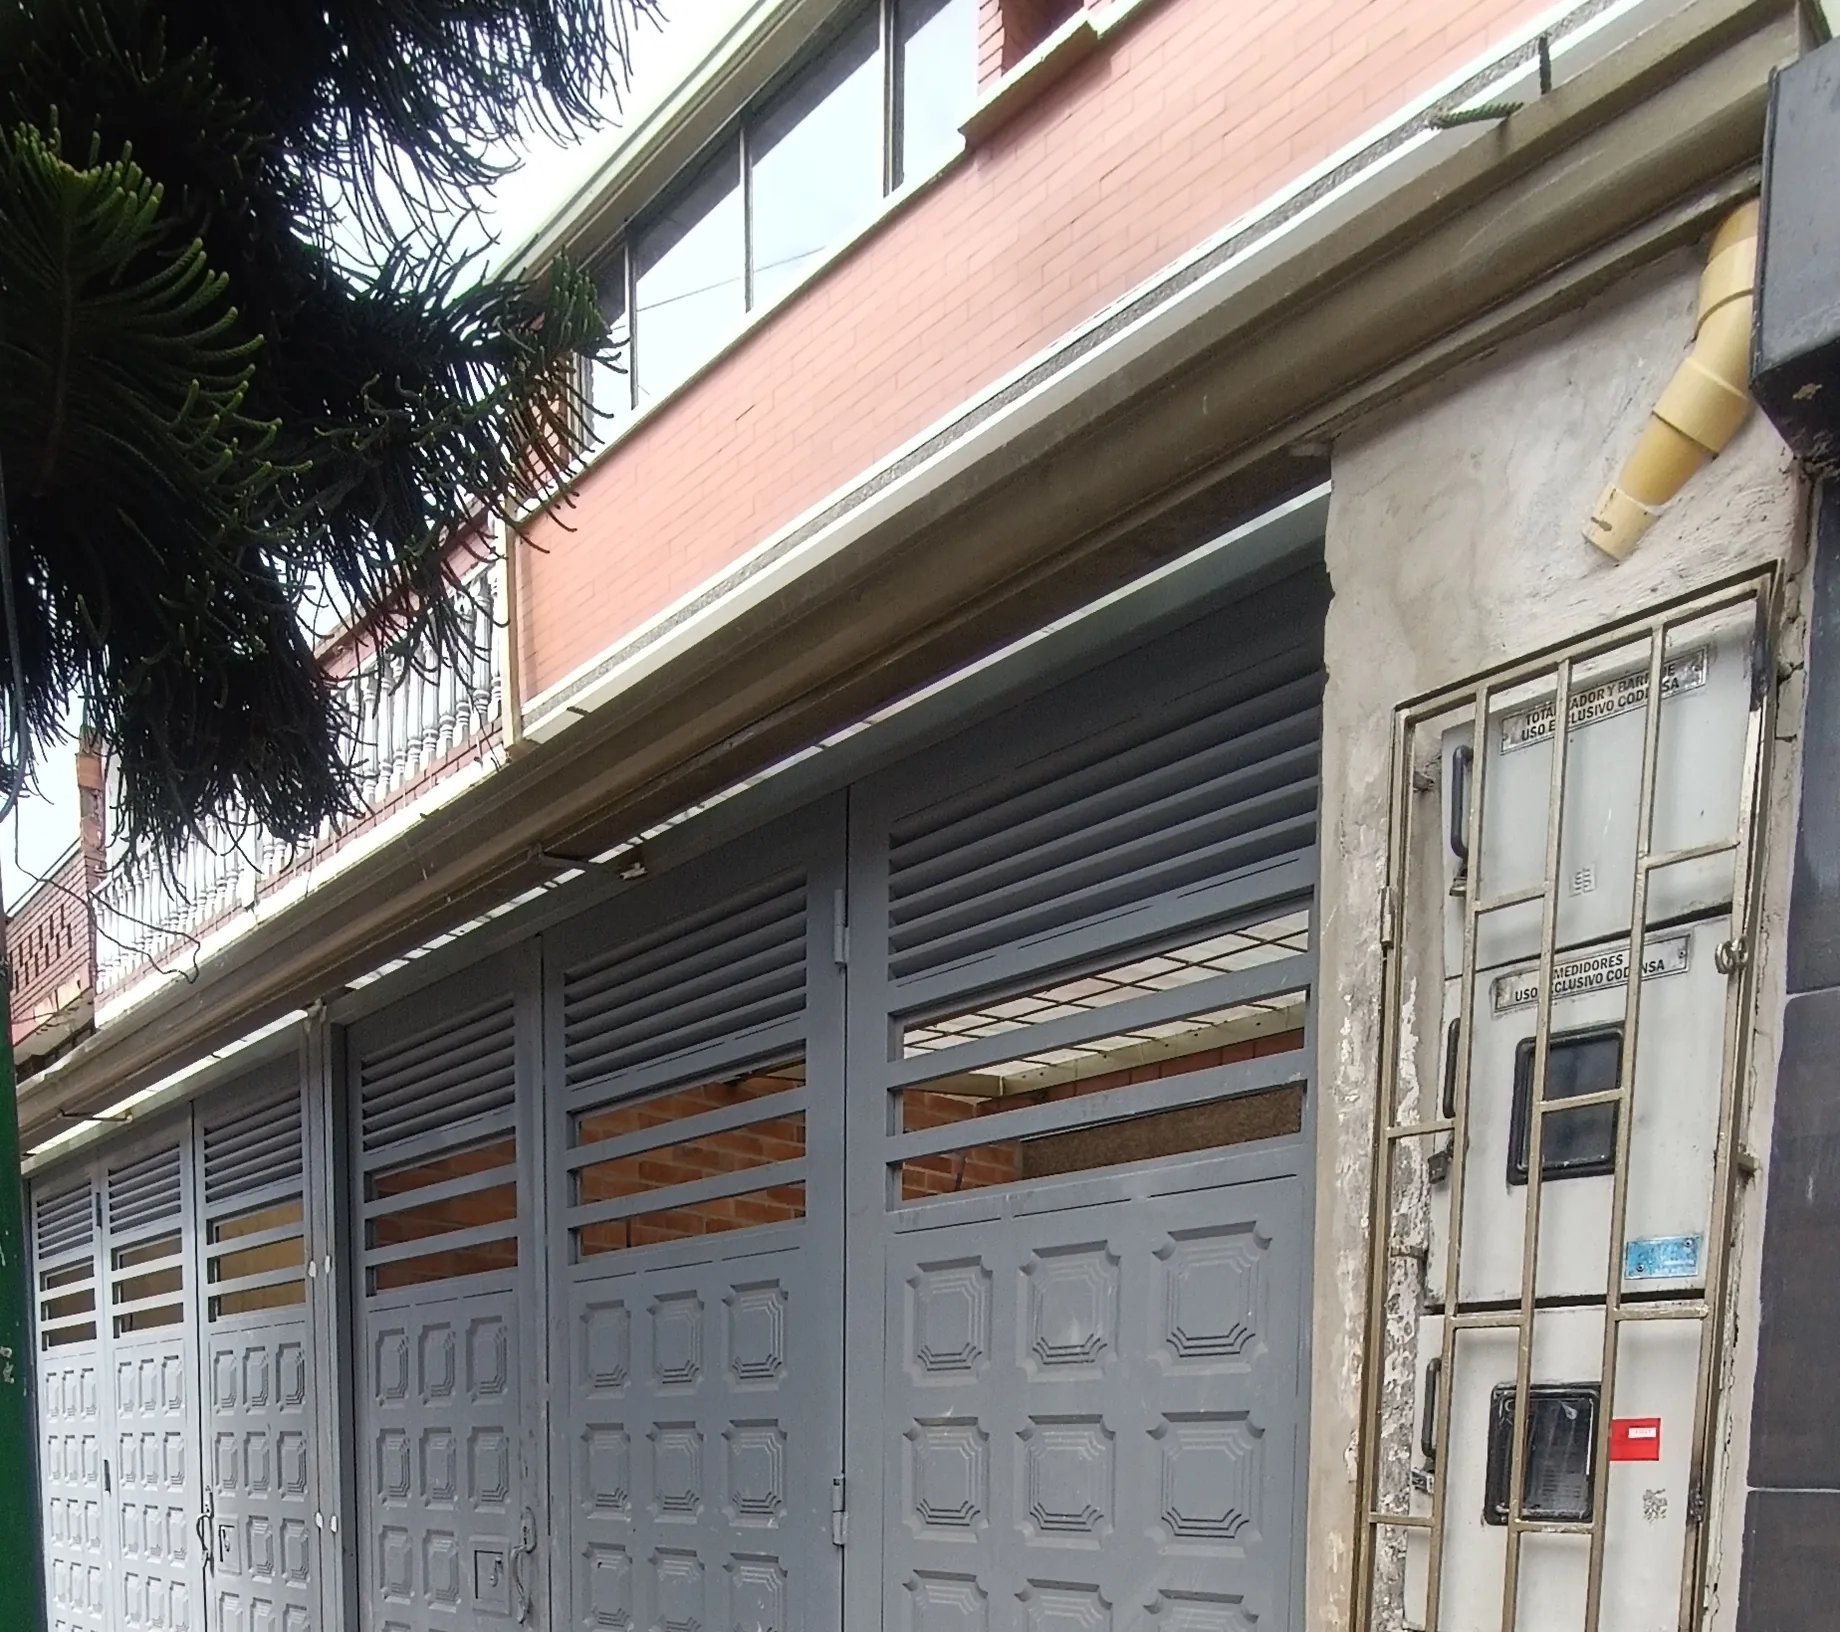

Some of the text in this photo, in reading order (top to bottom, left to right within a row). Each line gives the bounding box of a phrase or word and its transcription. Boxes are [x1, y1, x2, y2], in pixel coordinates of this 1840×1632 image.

[1521, 677, 1680, 741] USO ELUSIVO CODSA
[1525, 663, 1676, 726] TOTAADOR Y BARE
[1515, 959, 1665, 1002] USO CLUSIVO CODNSA
[1553, 954, 1623, 980] MEDIDORES
